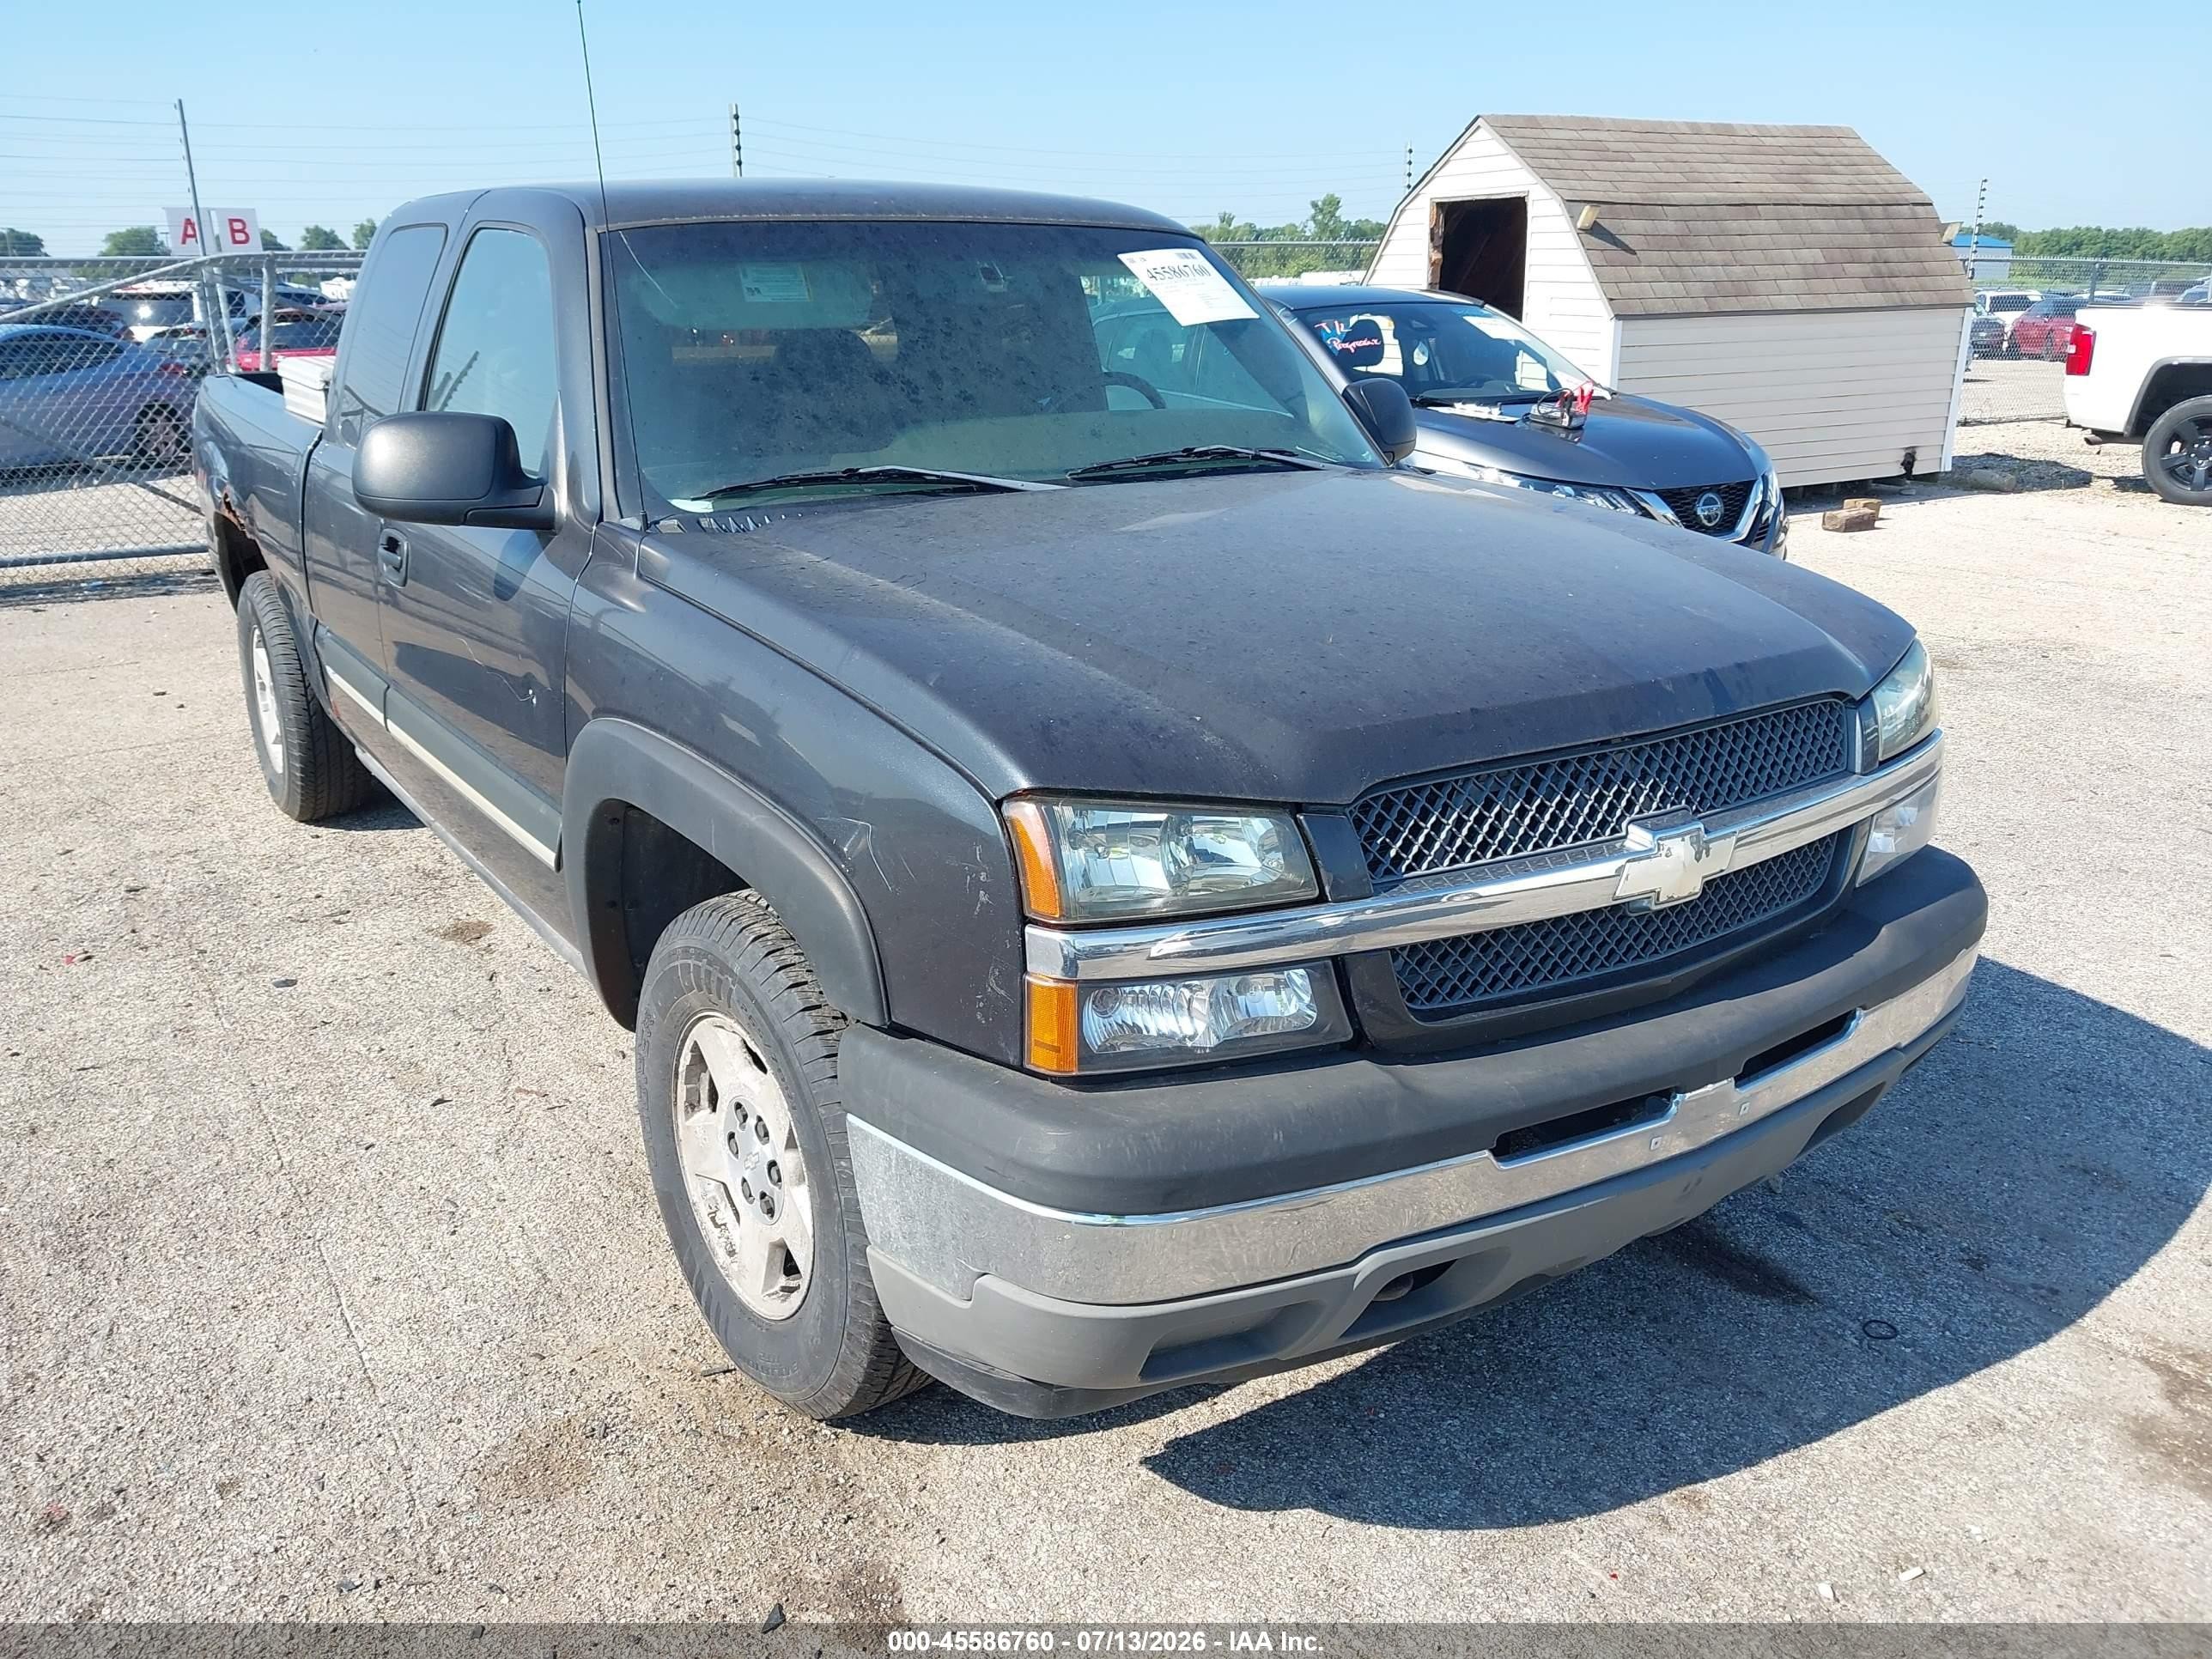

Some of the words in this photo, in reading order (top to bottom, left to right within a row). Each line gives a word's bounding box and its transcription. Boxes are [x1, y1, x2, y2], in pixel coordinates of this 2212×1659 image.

[180, 217, 199, 245] A
[228, 218, 251, 245] B
[1146, 264, 1212, 282] 45586760
